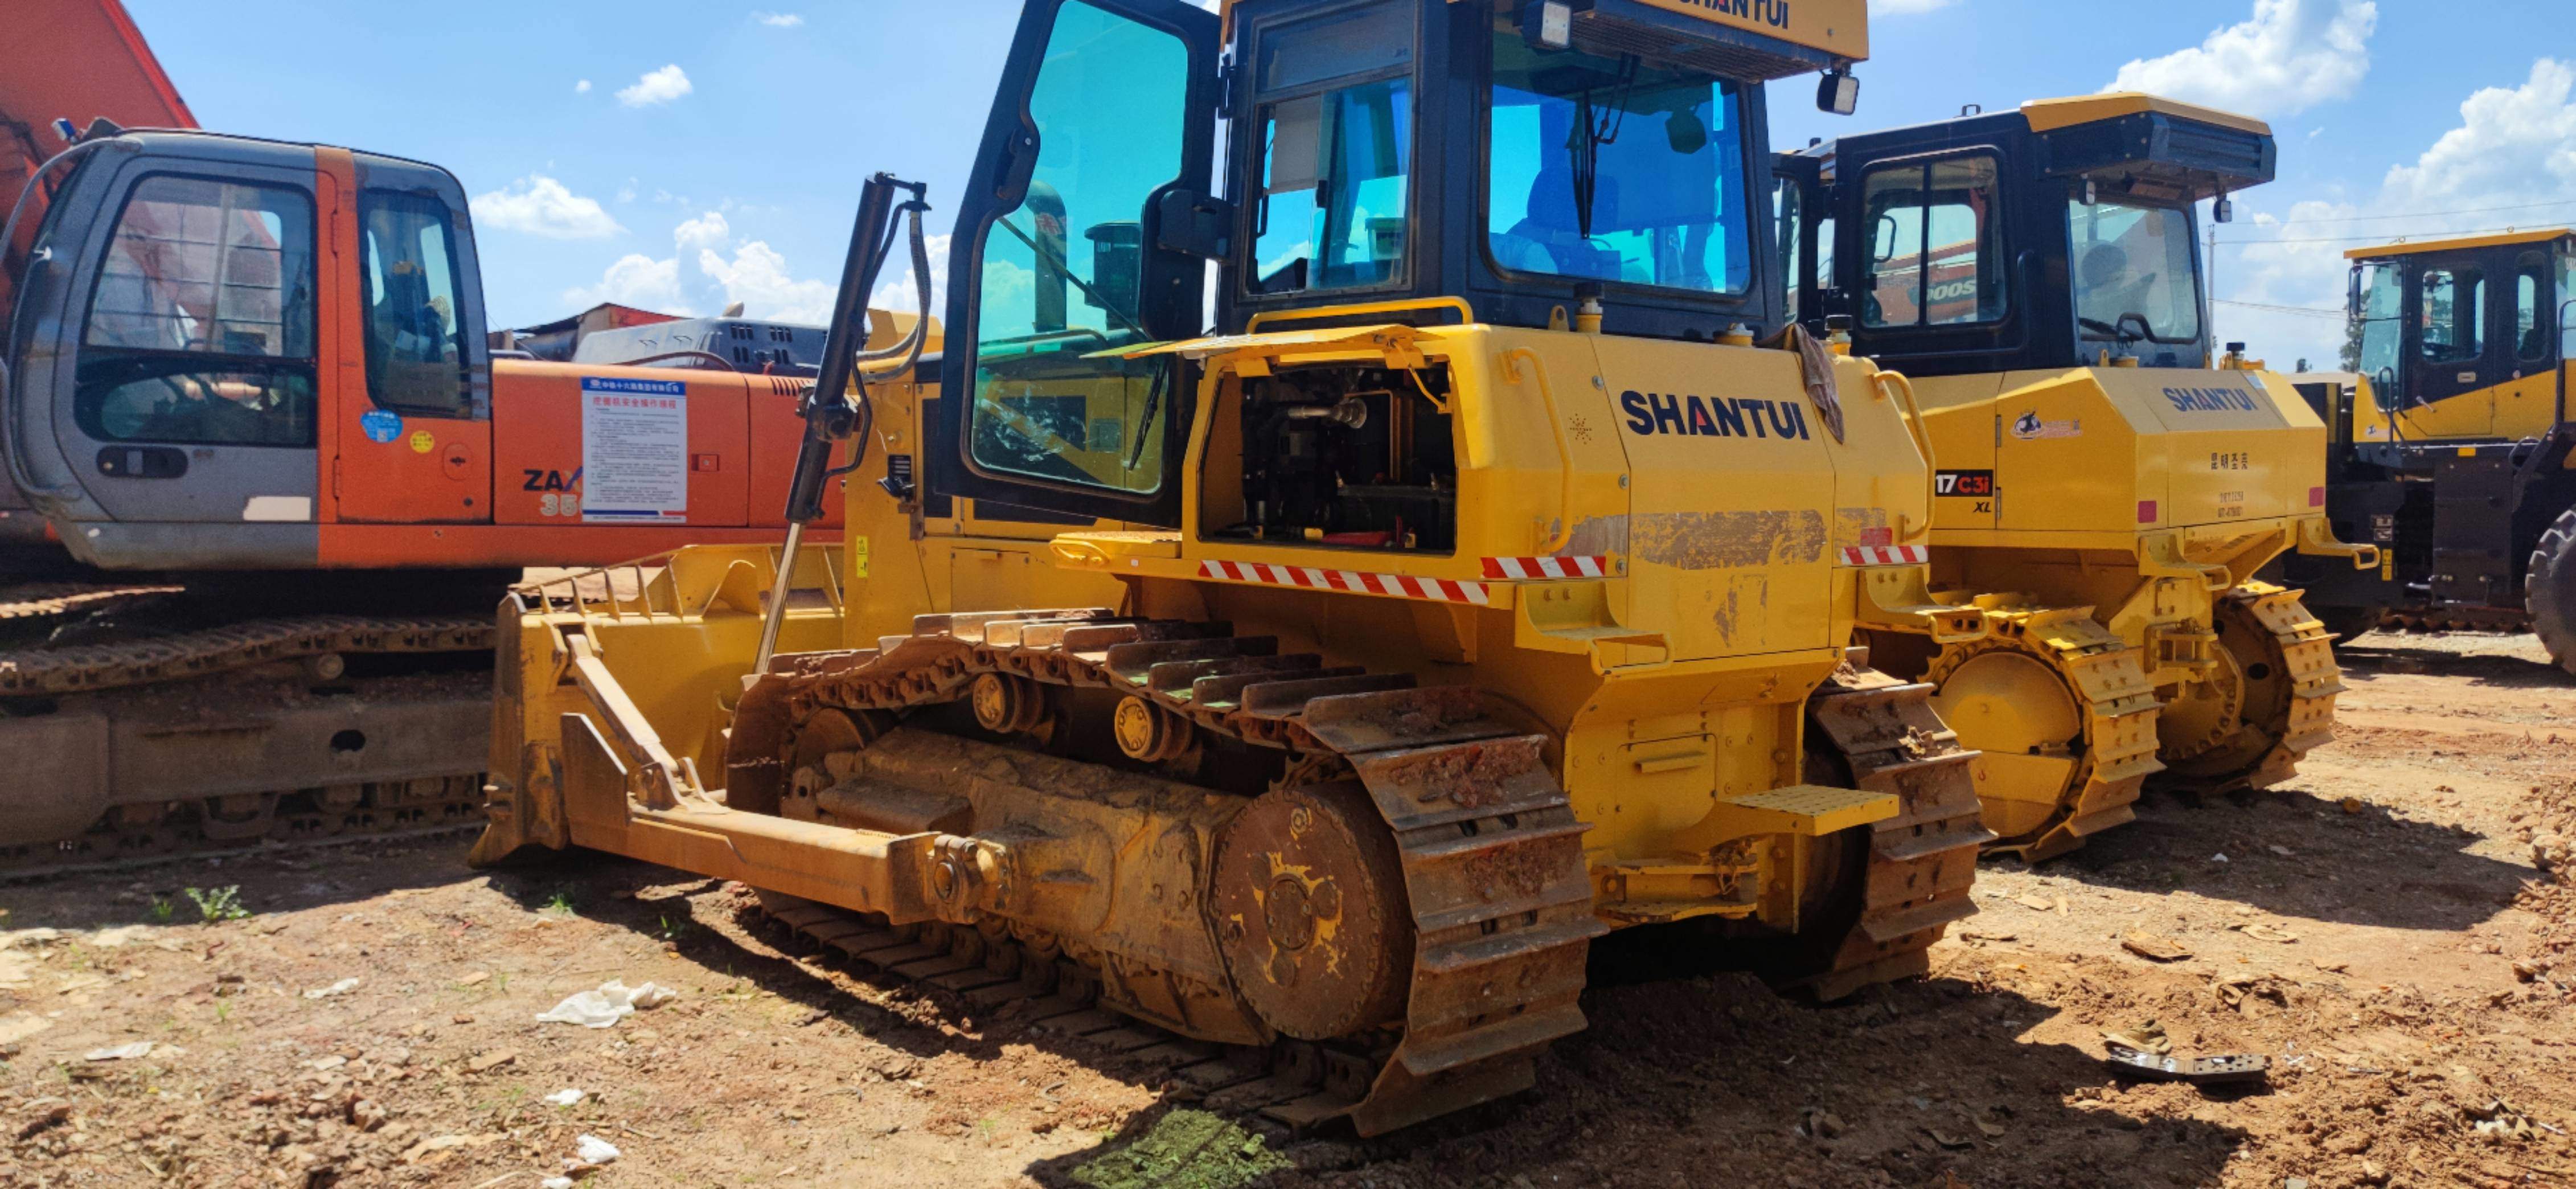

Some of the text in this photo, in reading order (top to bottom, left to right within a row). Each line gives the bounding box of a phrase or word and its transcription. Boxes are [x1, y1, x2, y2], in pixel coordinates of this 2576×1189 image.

[2163, 388, 2258, 412] SHANTUI
[1621, 391, 1810, 441] SHANTUI
[540, 494, 583, 516] 35
[1973, 502, 1992, 512] XL
